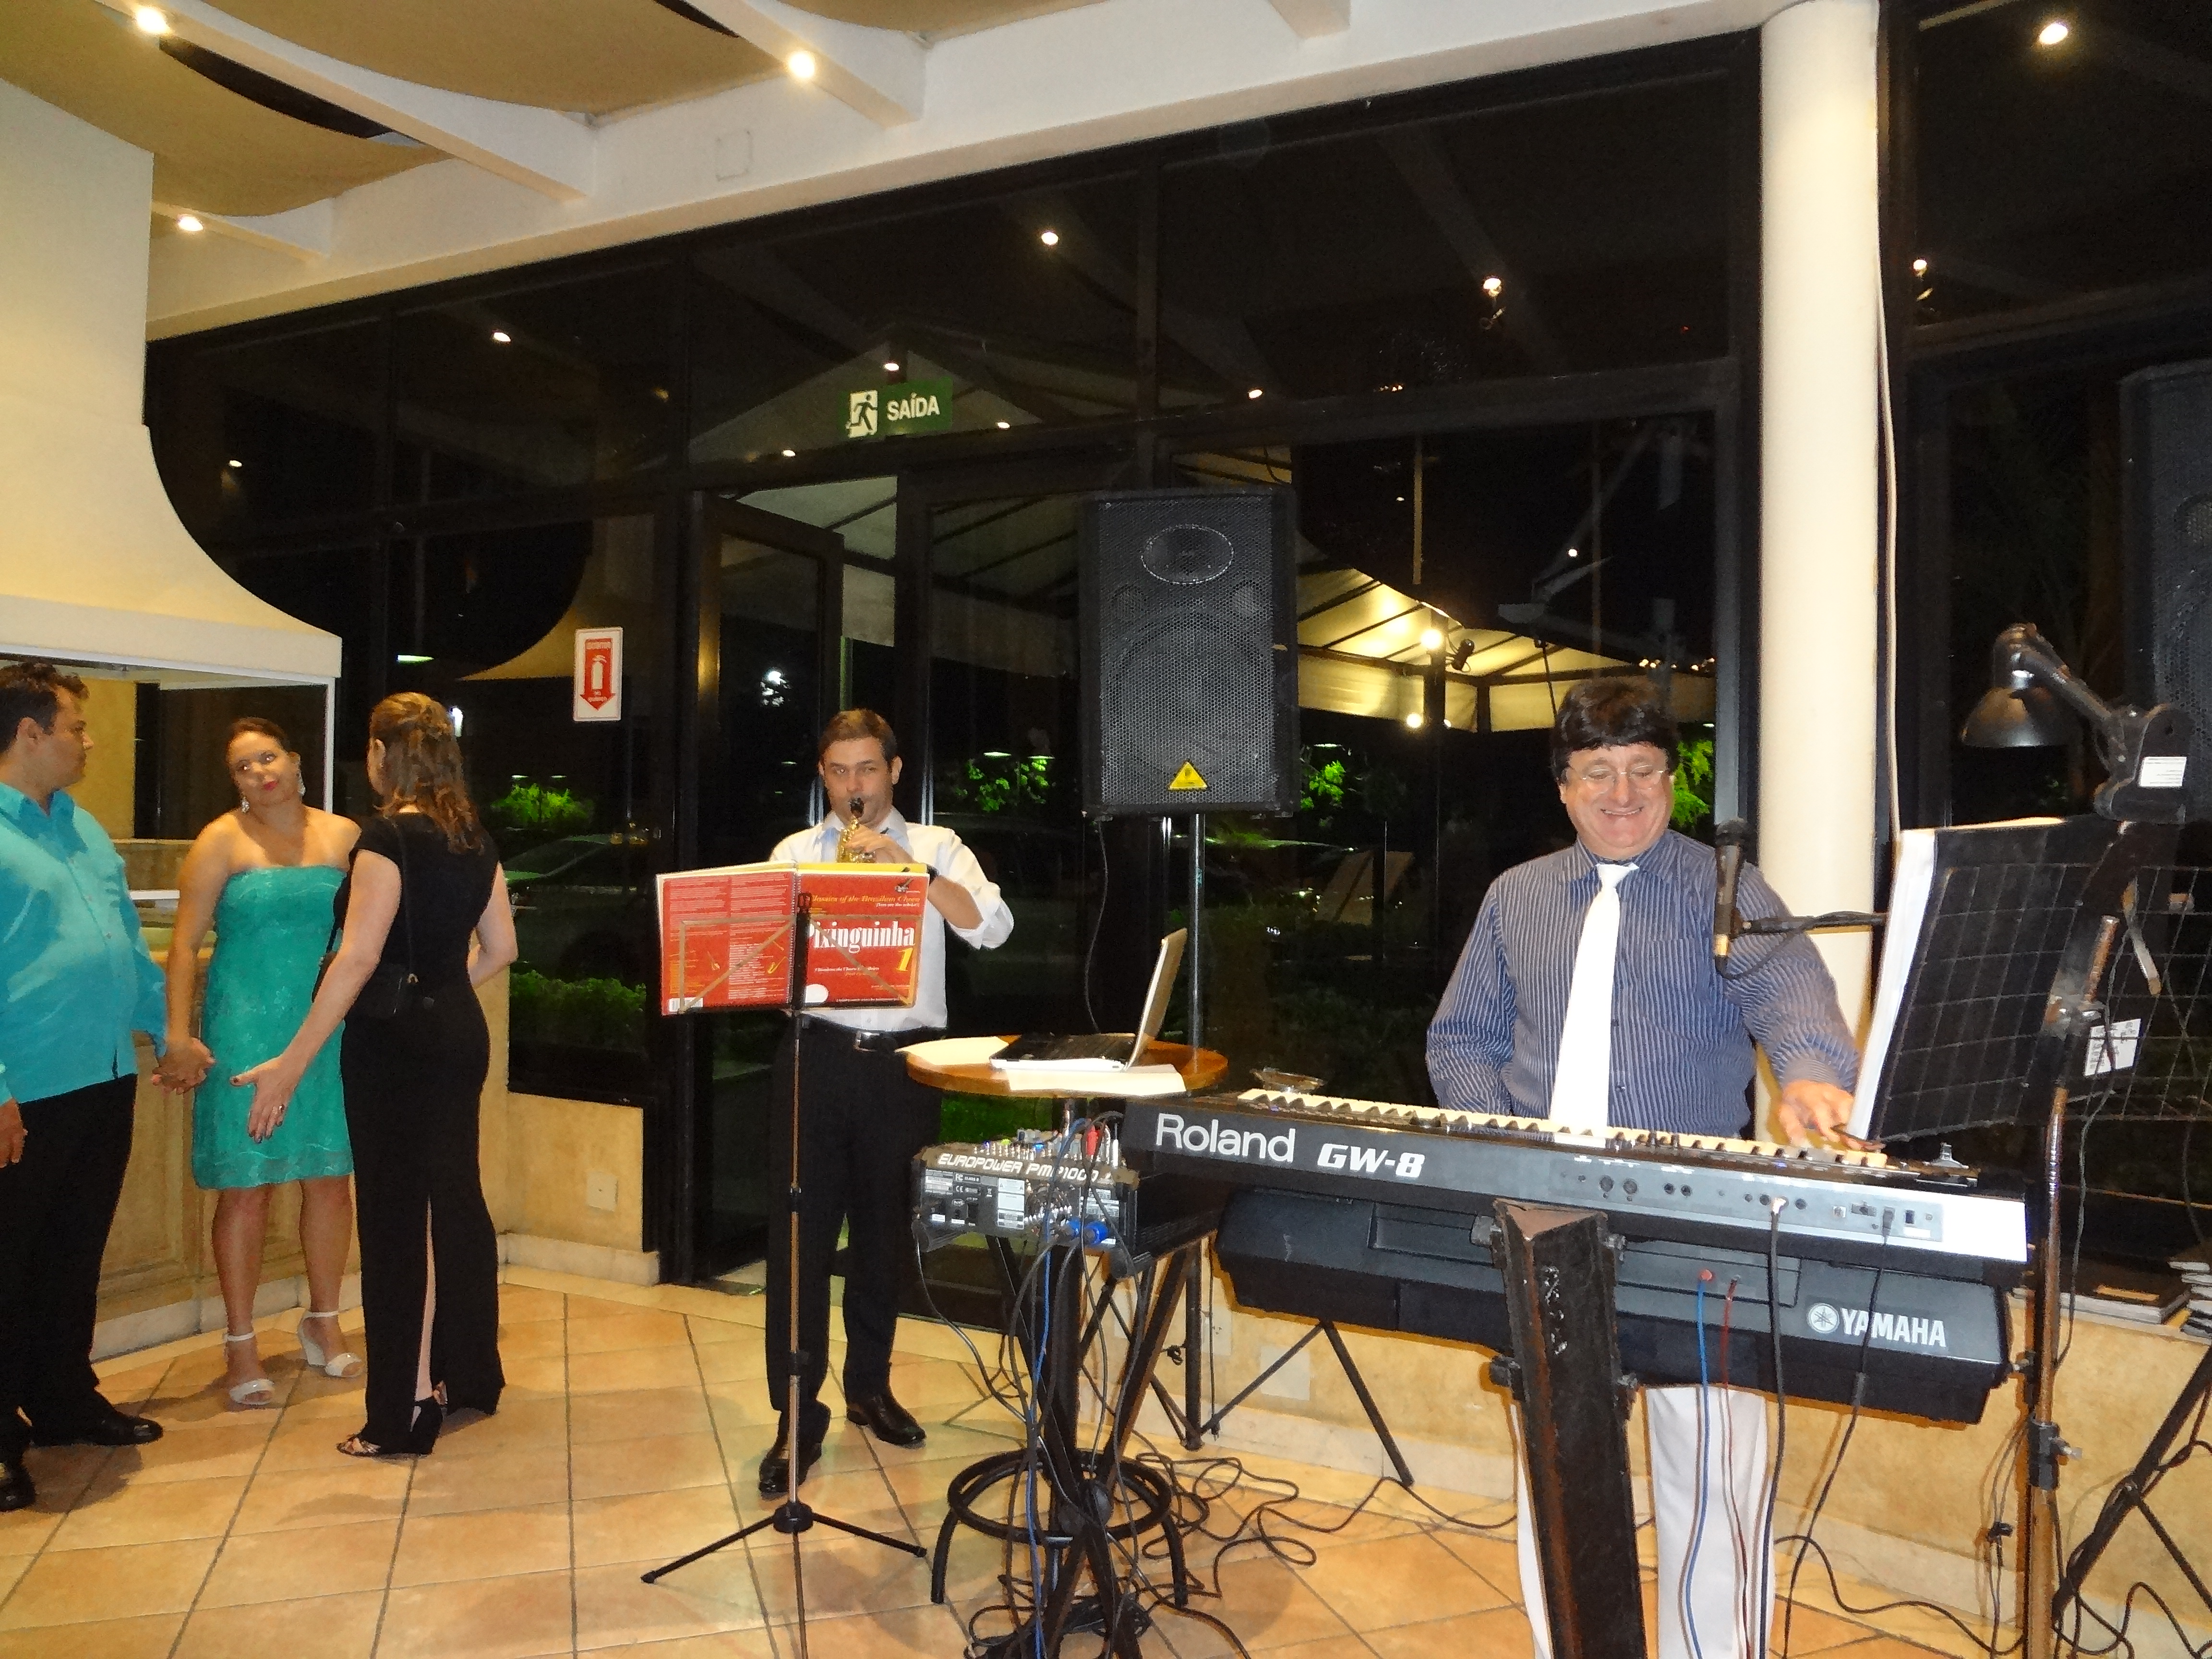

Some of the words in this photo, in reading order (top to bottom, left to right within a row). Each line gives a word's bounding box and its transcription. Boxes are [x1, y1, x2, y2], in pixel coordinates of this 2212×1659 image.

[887, 392, 940, 421] SAÍDA
[896, 948, 914, 972] 1
[1156, 1113, 1296, 1163] Roland
[1317, 1143, 1426, 1178] GW-8
[938, 1153, 1023, 1174] EUROPOWER
[1840, 1308, 1947, 1347] YAMAHA
